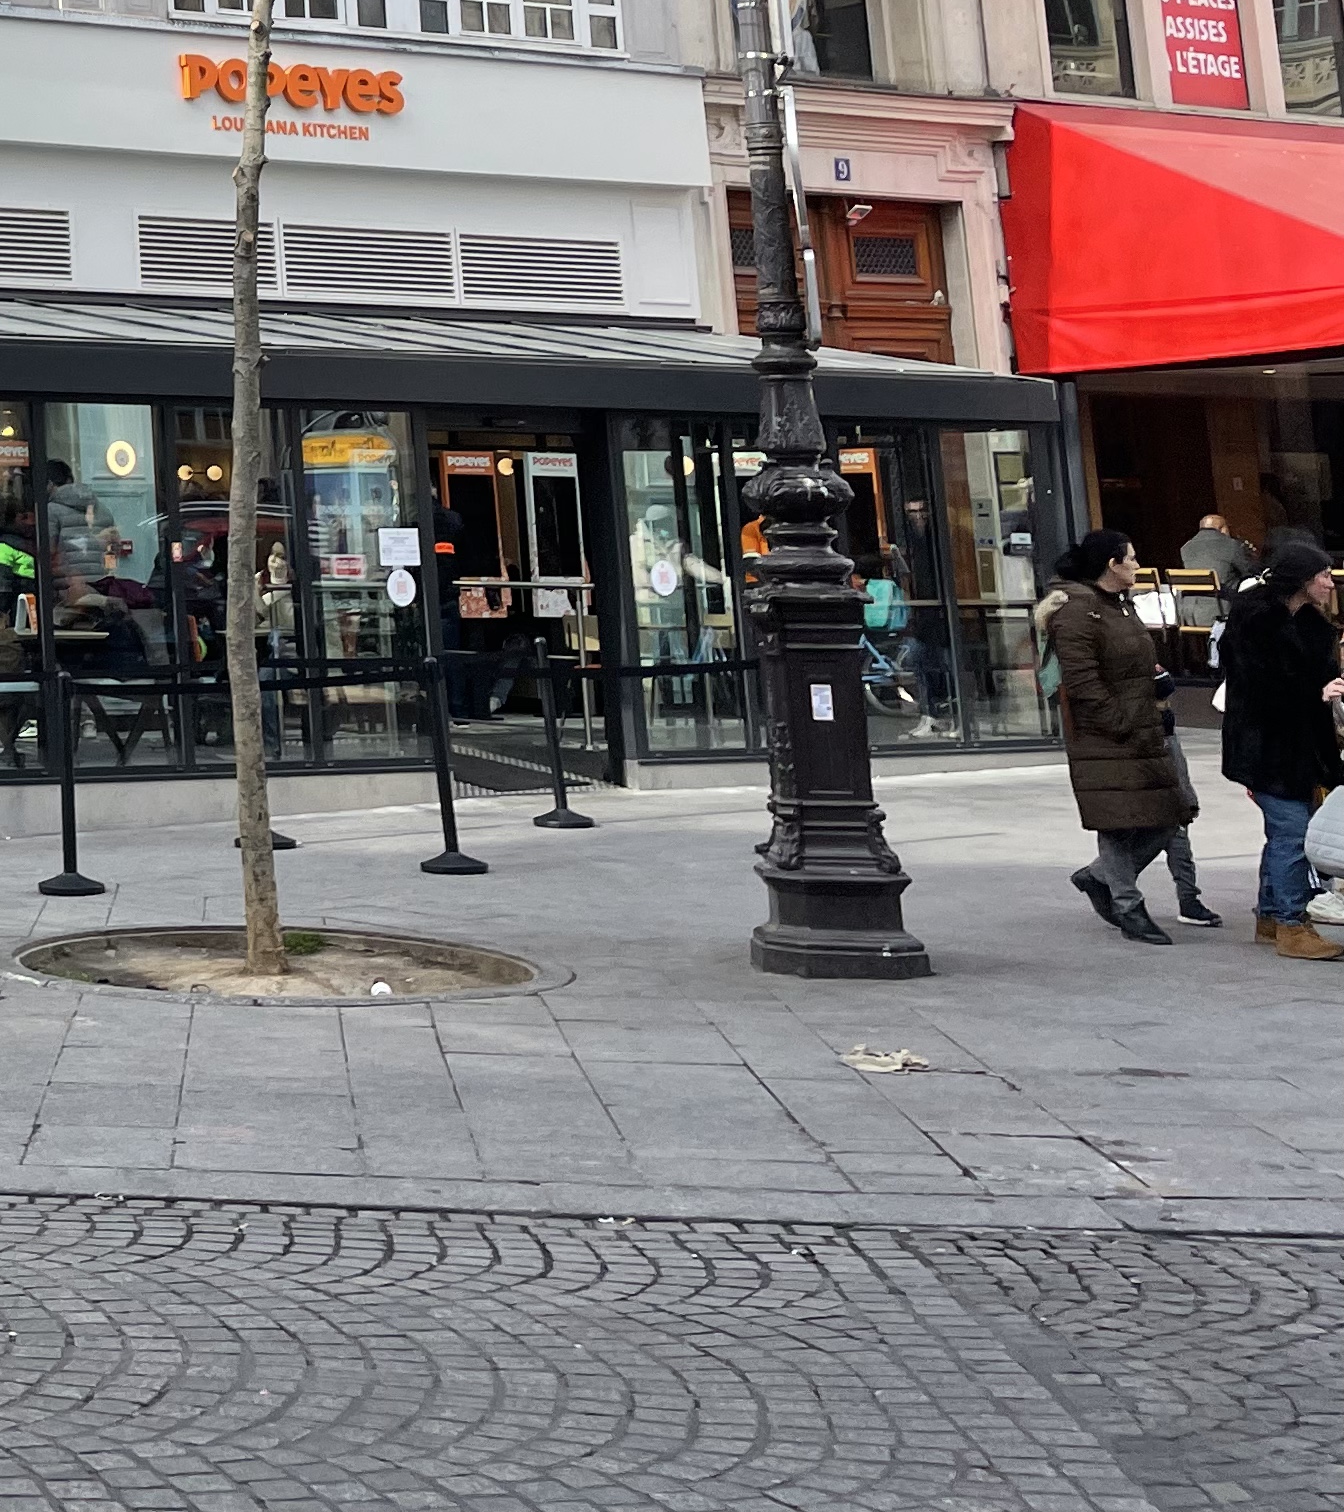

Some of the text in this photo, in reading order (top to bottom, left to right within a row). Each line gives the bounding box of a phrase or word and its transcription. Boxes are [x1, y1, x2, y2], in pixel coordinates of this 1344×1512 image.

[1165, 16, 1228, 43] ASSISES
[1176, 47, 1242, 79] L'ÉTAGE
[212, 115, 370, 141] LOUANA KITCHEN
[837, 161, 849, 179] 9
